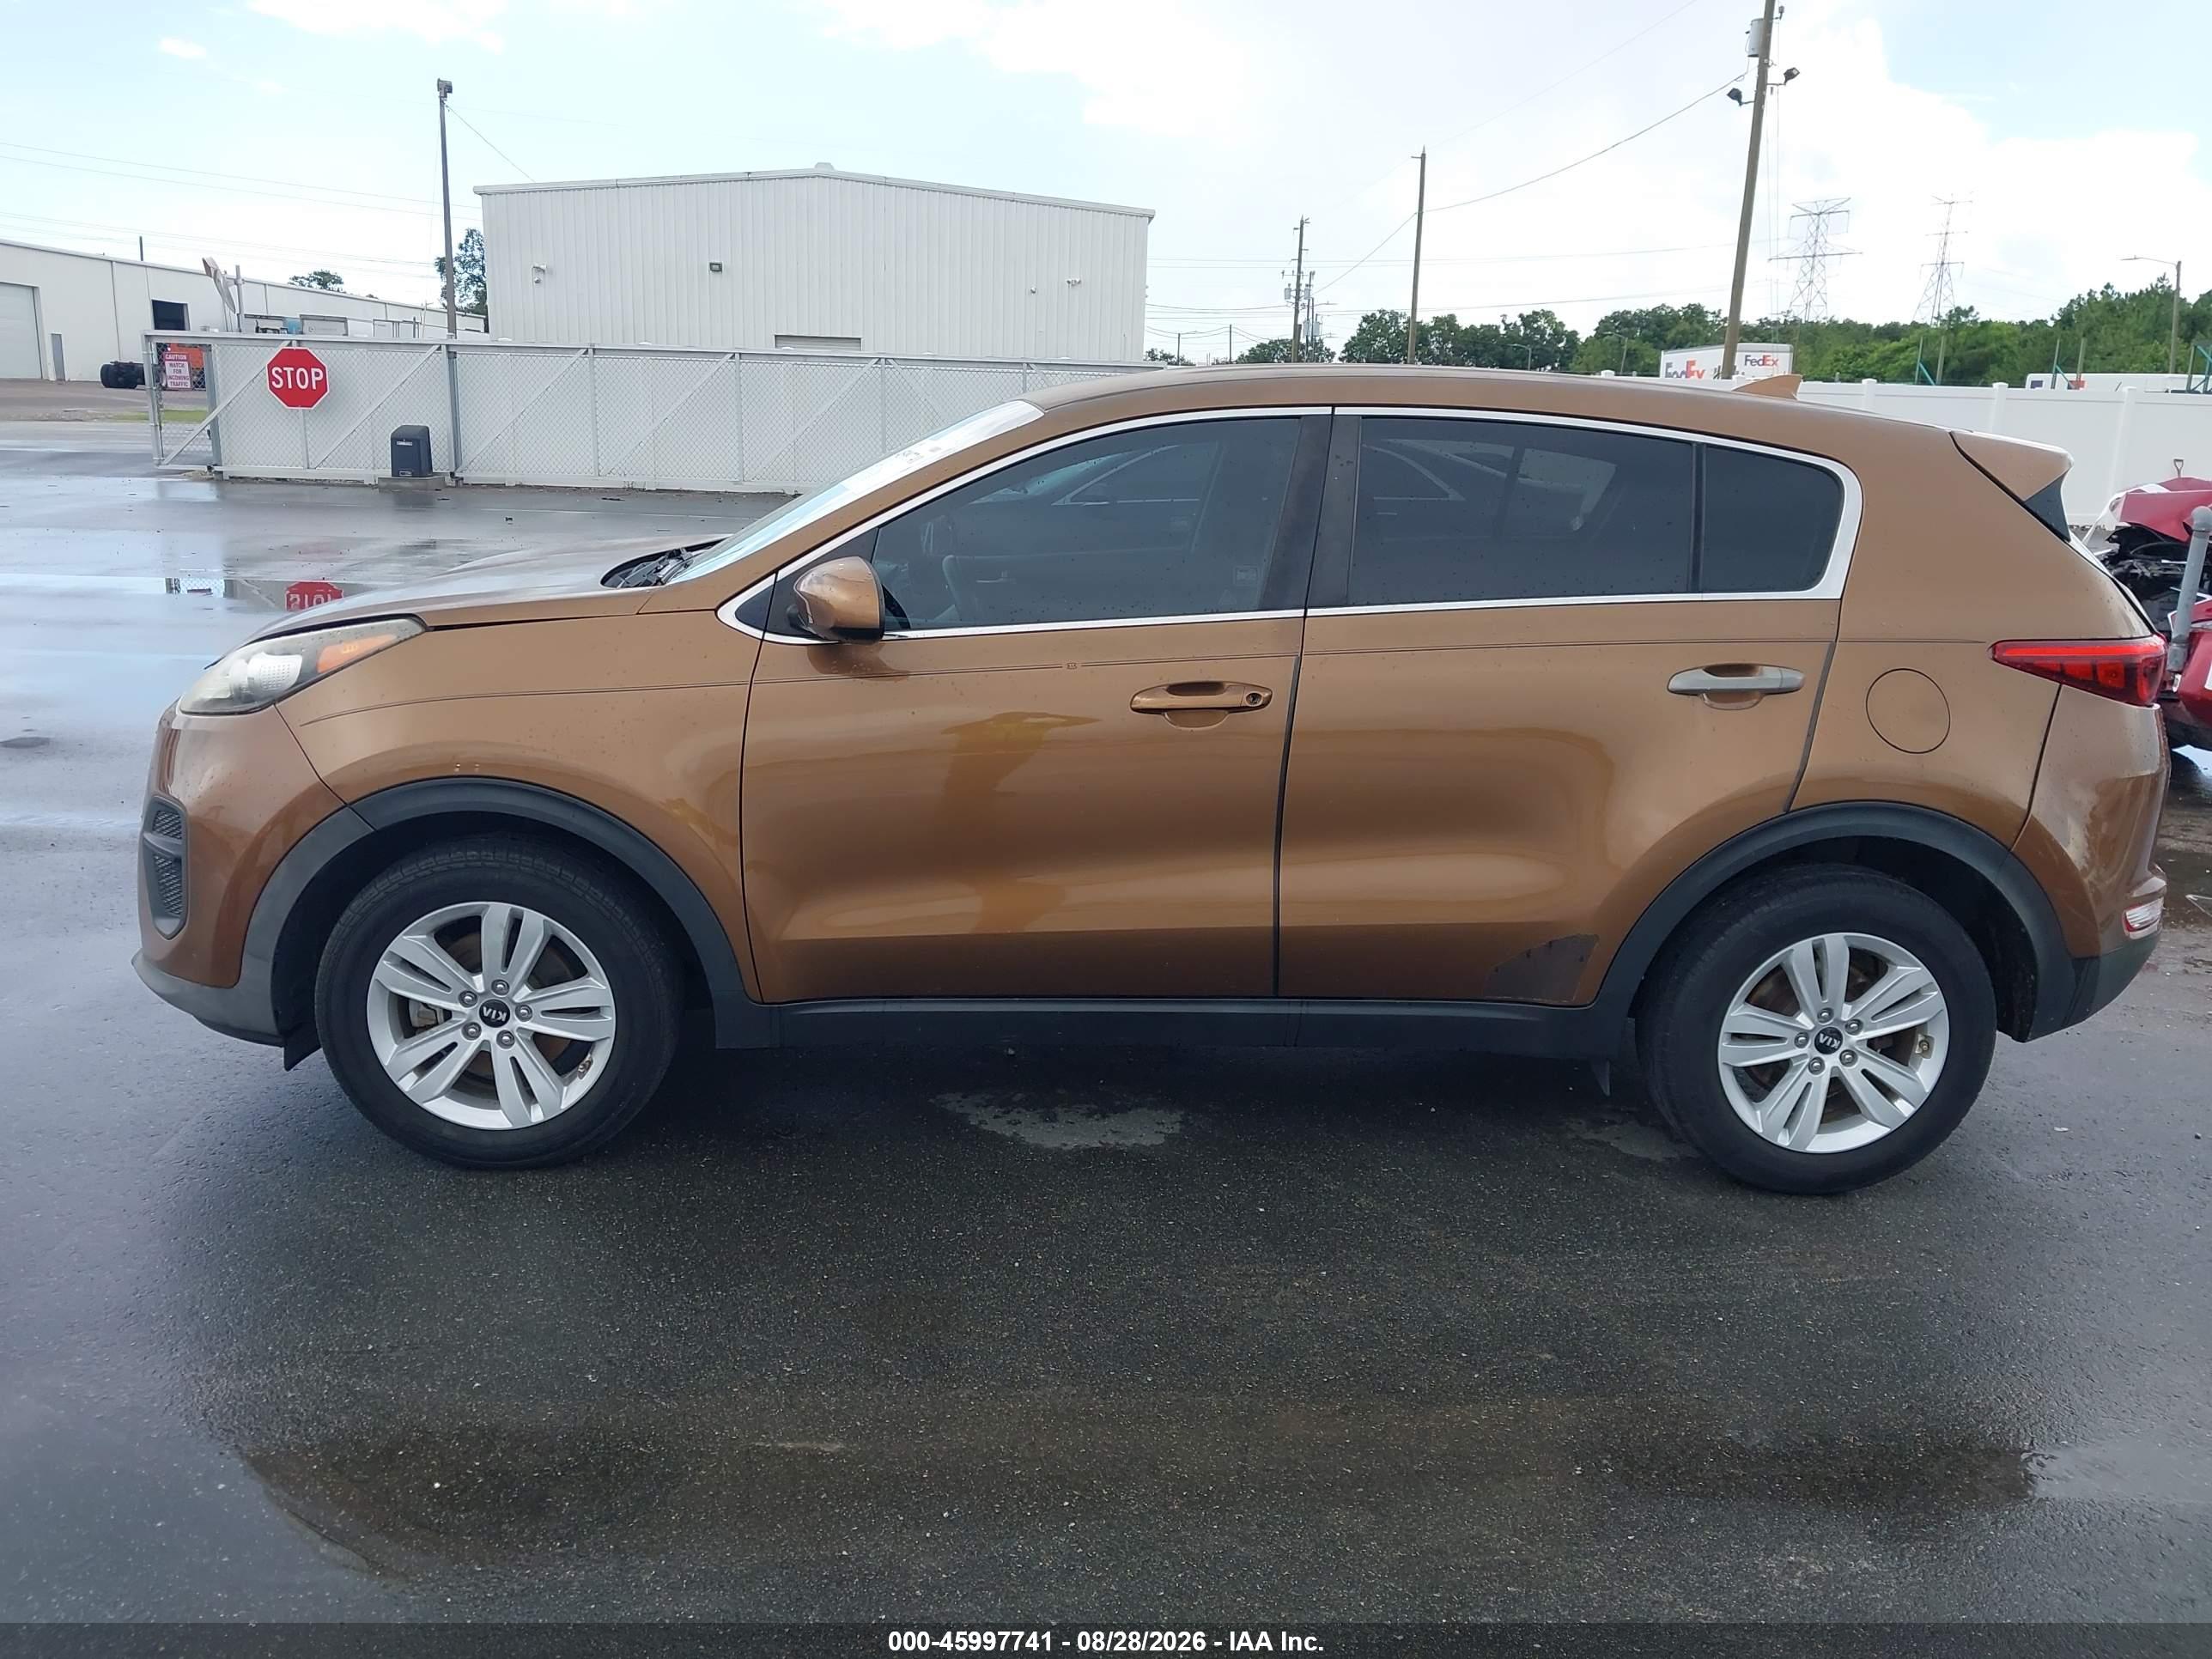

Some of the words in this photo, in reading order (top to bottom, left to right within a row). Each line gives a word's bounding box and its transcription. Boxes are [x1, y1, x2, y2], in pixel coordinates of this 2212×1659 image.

[1744, 355, 1779, 367] FedEx
[271, 366, 324, 390] STOP
[483, 1006, 507, 1022] KIA
[1820, 1032, 1841, 1049] KIA
